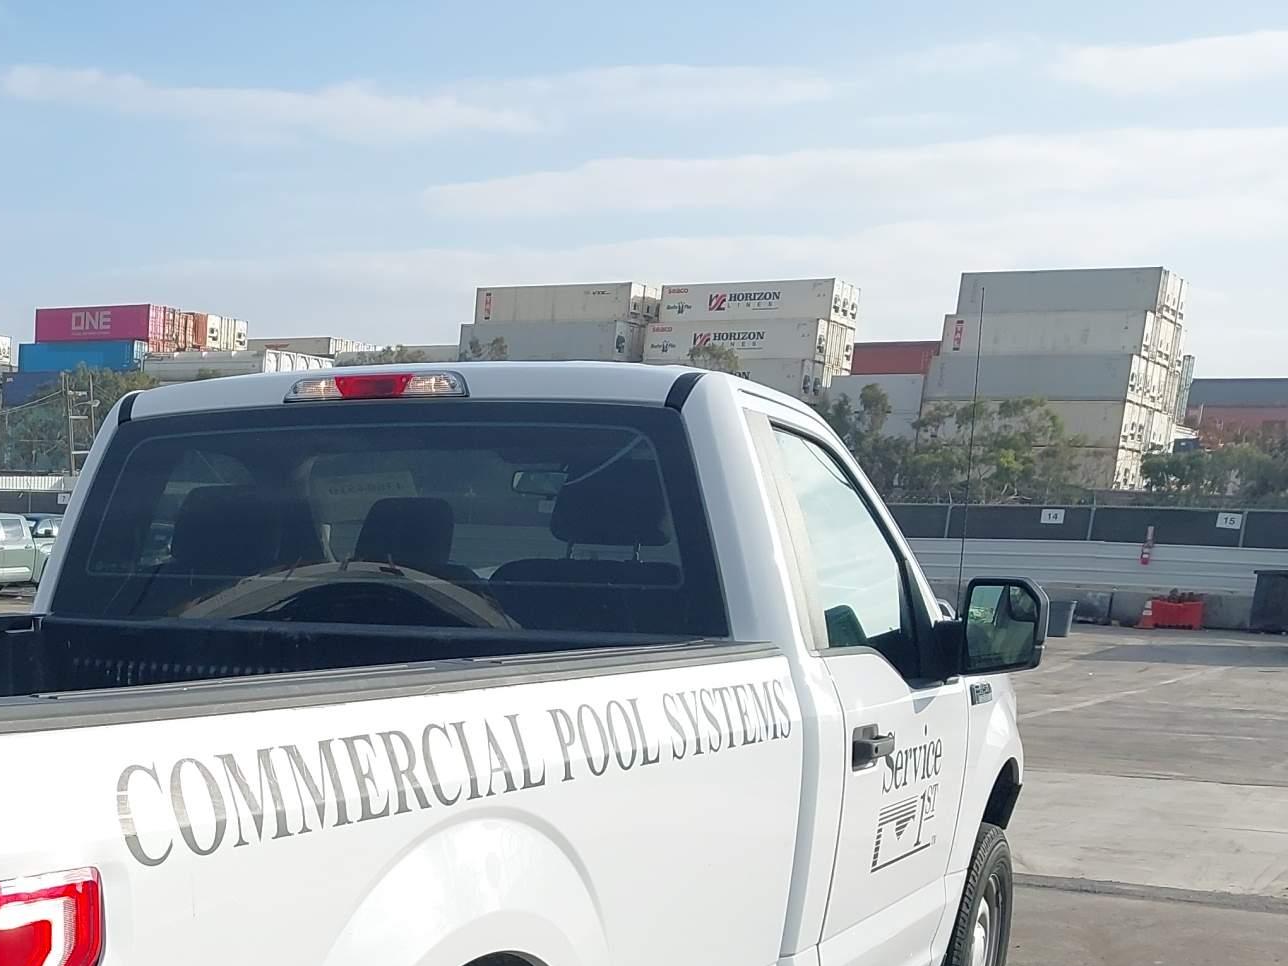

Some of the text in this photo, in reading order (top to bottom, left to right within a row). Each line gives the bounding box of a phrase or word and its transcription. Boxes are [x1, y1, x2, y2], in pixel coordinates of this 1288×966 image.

[729, 291, 781, 302] HORIZON
[71, 311, 112, 330] ONE
[713, 331, 765, 341] HORIZON
[1047, 512, 1059, 521] 14
[1223, 516, 1236, 525] 15
[881, 723, 943, 796] Service
[116, 679, 792, 867] COMMERCIAL POOL SYSTEMS
